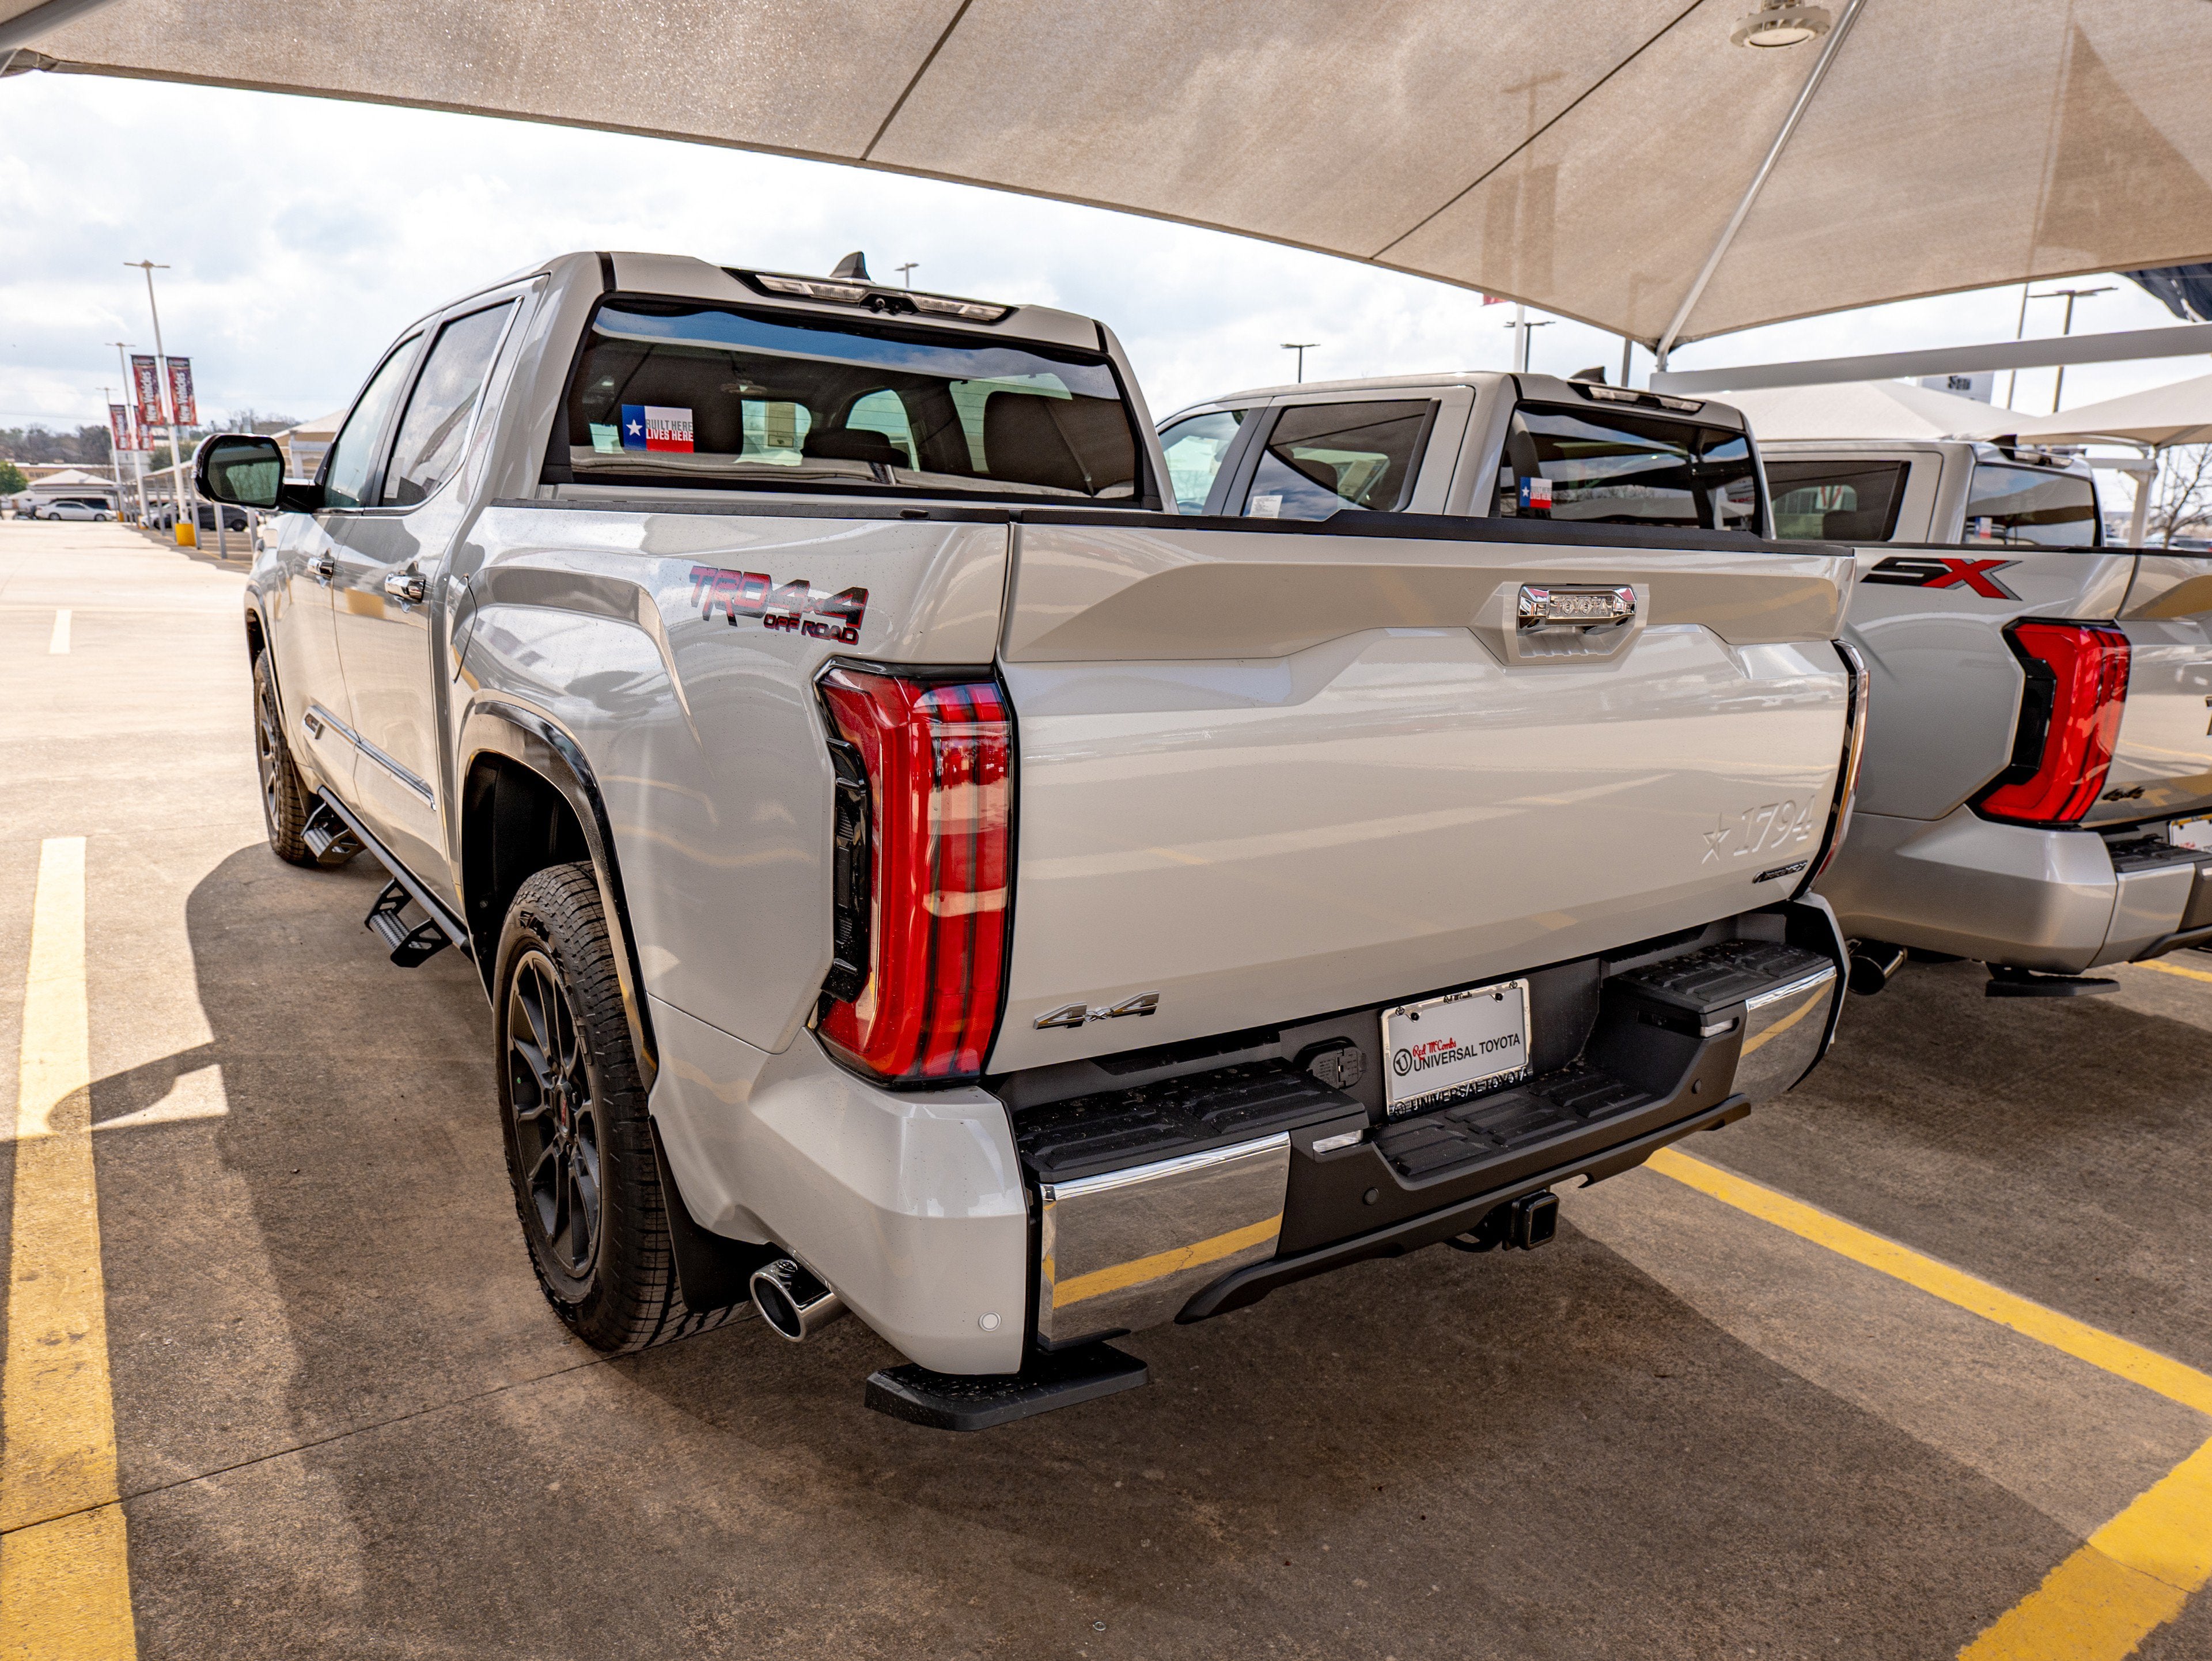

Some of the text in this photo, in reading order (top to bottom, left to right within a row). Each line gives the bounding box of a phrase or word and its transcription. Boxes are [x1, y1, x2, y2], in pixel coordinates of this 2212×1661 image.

[646, 419, 693, 432] BUILT HERE
[646, 428, 694, 441] LIVES HERE
[690, 565, 772, 627] TRD
[1554, 596, 1609, 616] TOYOTA
[763, 614, 859, 645] OFF ROAD
[1733, 795, 1815, 857] 1794
[1412, 1044, 1426, 1060] Red
[1414, 1033, 1520, 1072] UNIVERSAL TOYOTA
[1411, 1066, 1528, 1111] UNIVERSAL TOYOTA
